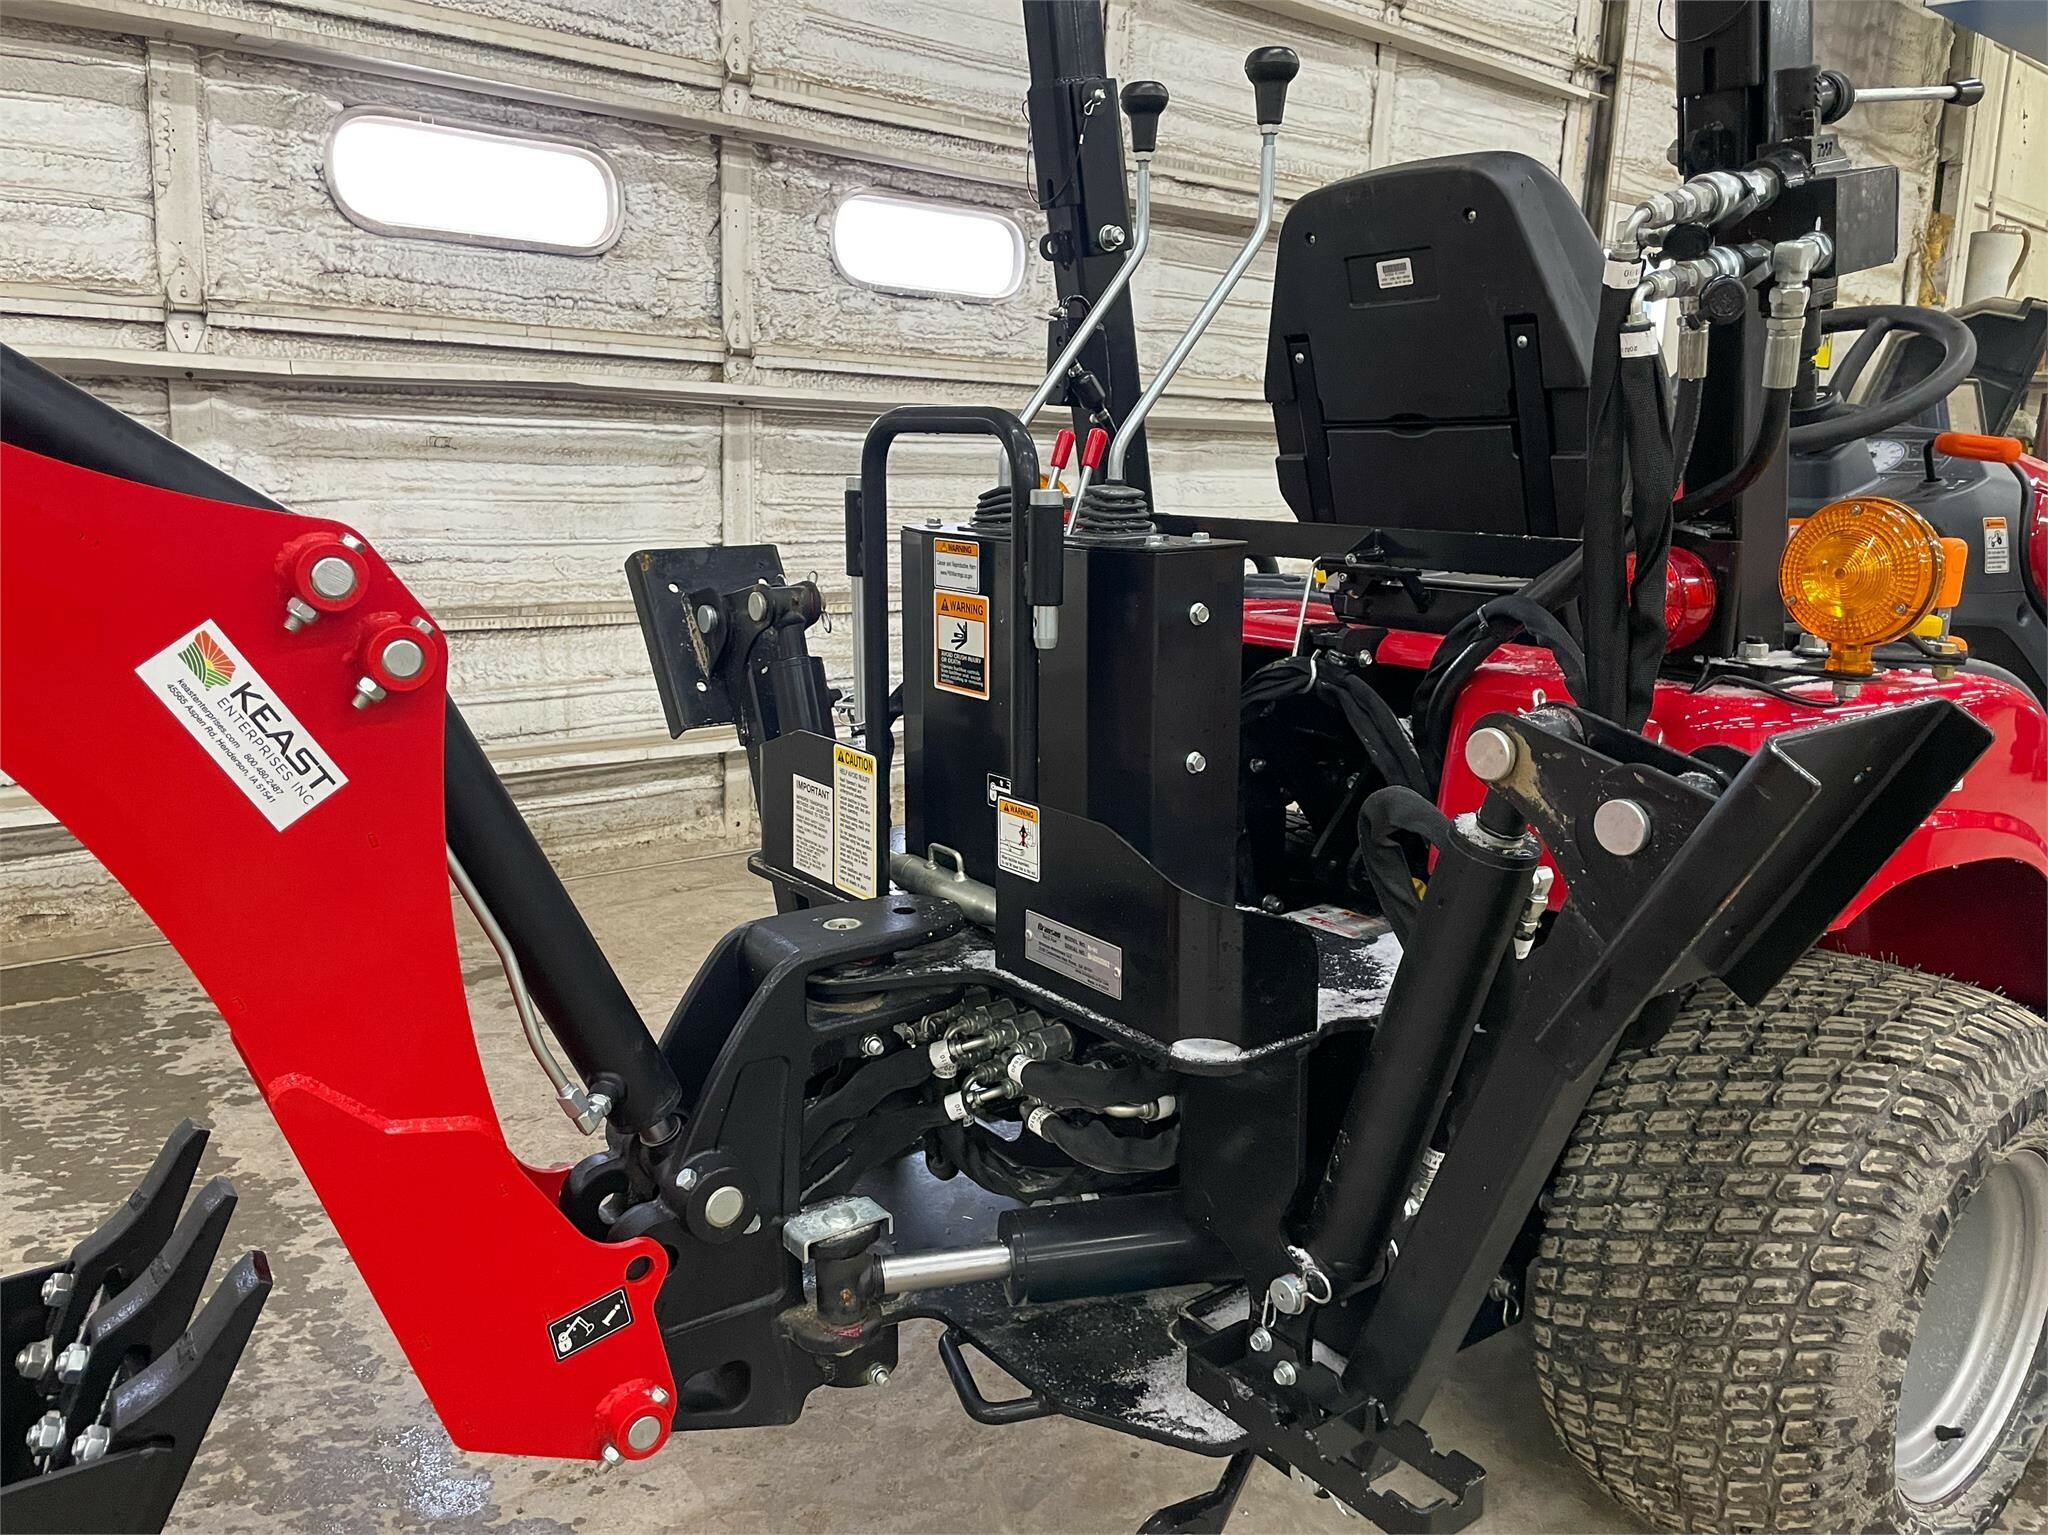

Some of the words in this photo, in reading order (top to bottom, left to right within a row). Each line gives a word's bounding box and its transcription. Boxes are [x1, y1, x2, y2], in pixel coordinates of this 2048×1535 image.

[947, 543, 972, 554] WARNING
[950, 600, 984, 615] WARNING
[177, 678, 241, 749] keastenterprises.com
[166, 683, 186, 706] 45565
[184, 704, 208, 729] Aspen
[204, 725, 216, 740] Rd,
[215, 737, 250, 779] Henderson,
[248, 775, 258, 786] IA
[255, 781, 276, 804] 51541
[229, 681, 336, 790] KEAST
[216, 696, 294, 782] ENTERPRISES
[291, 781, 315, 806] INC
[845, 752, 873, 773] CAUTION
[796, 780, 830, 800] IMPORTANT
[1009, 806, 1034, 818] WARNING
